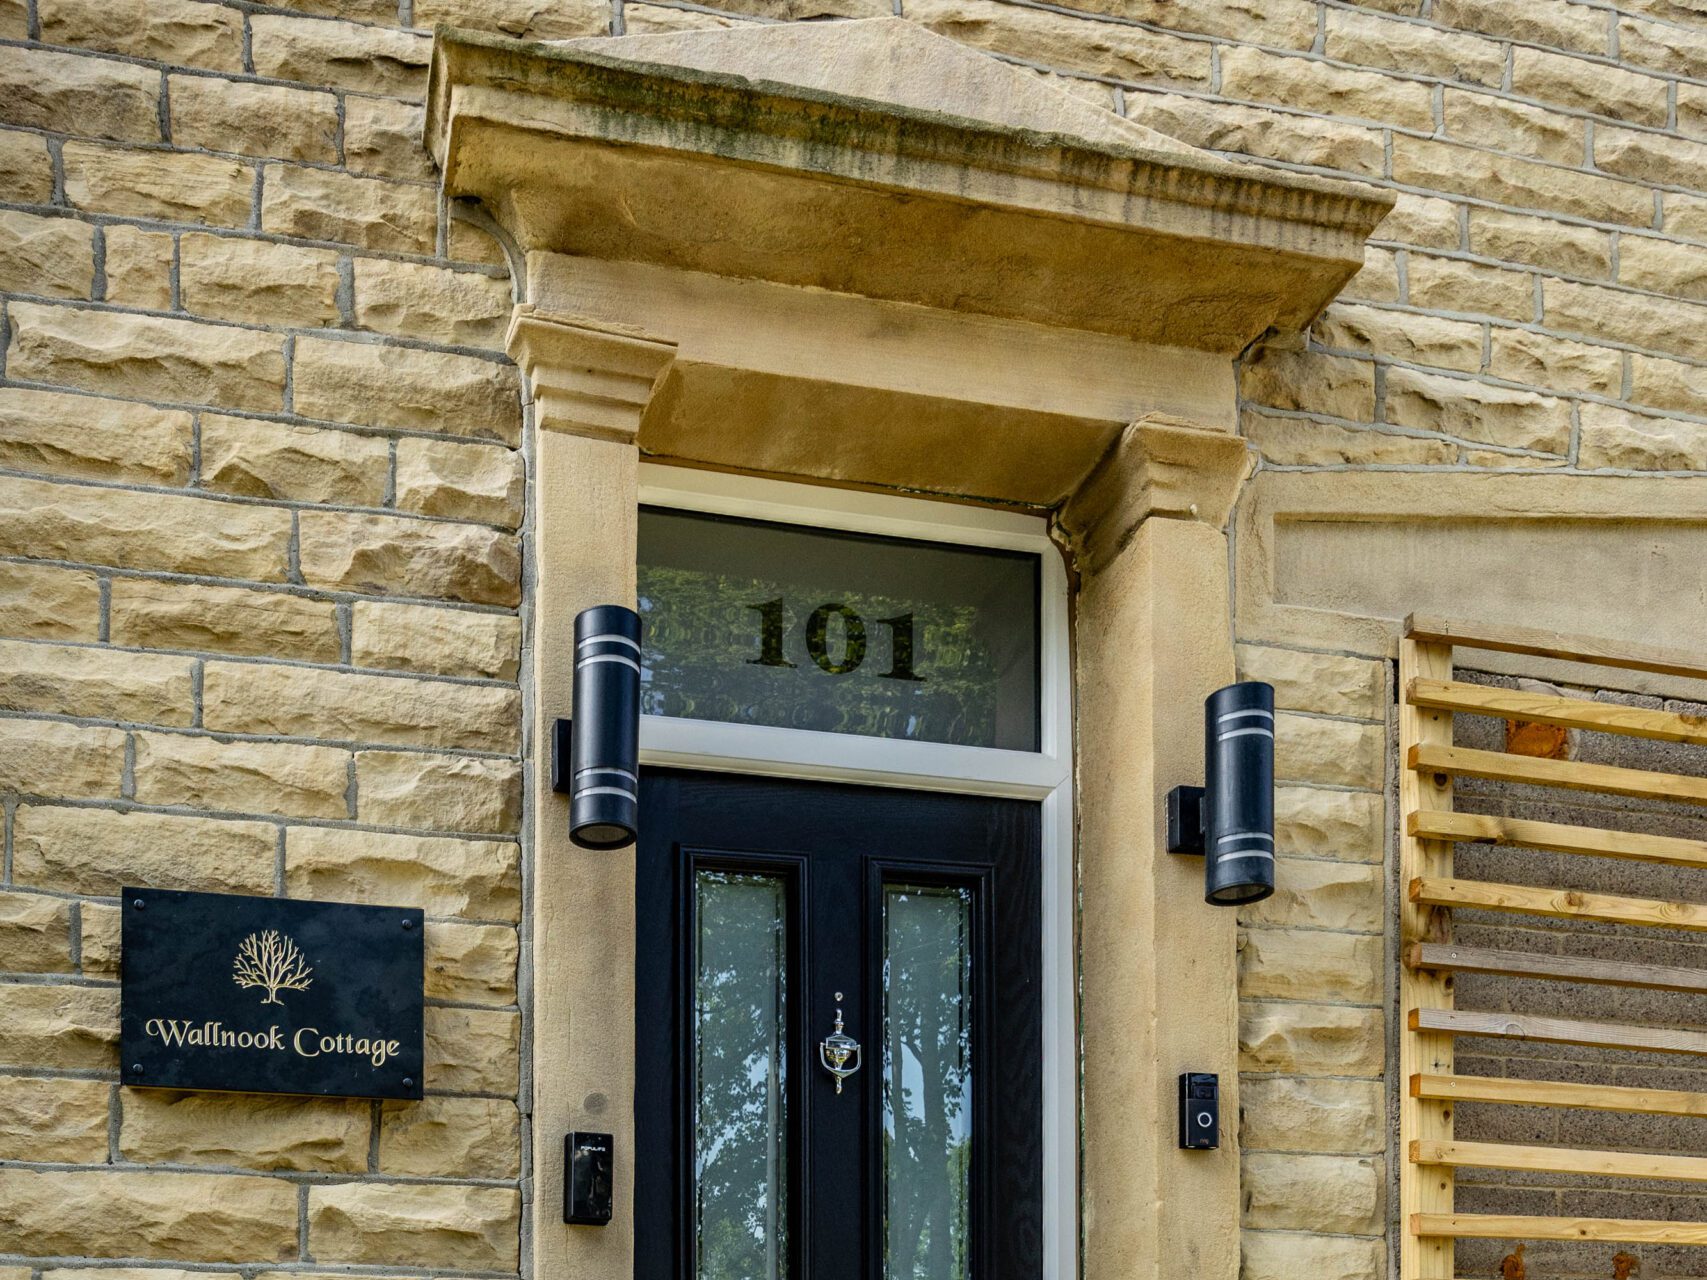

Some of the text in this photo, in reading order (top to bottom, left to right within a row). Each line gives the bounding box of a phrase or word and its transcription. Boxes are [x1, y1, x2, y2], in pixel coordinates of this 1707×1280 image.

[746, 597, 927, 682] 101
[145, 1018, 400, 1067] Wallnook Cottage
